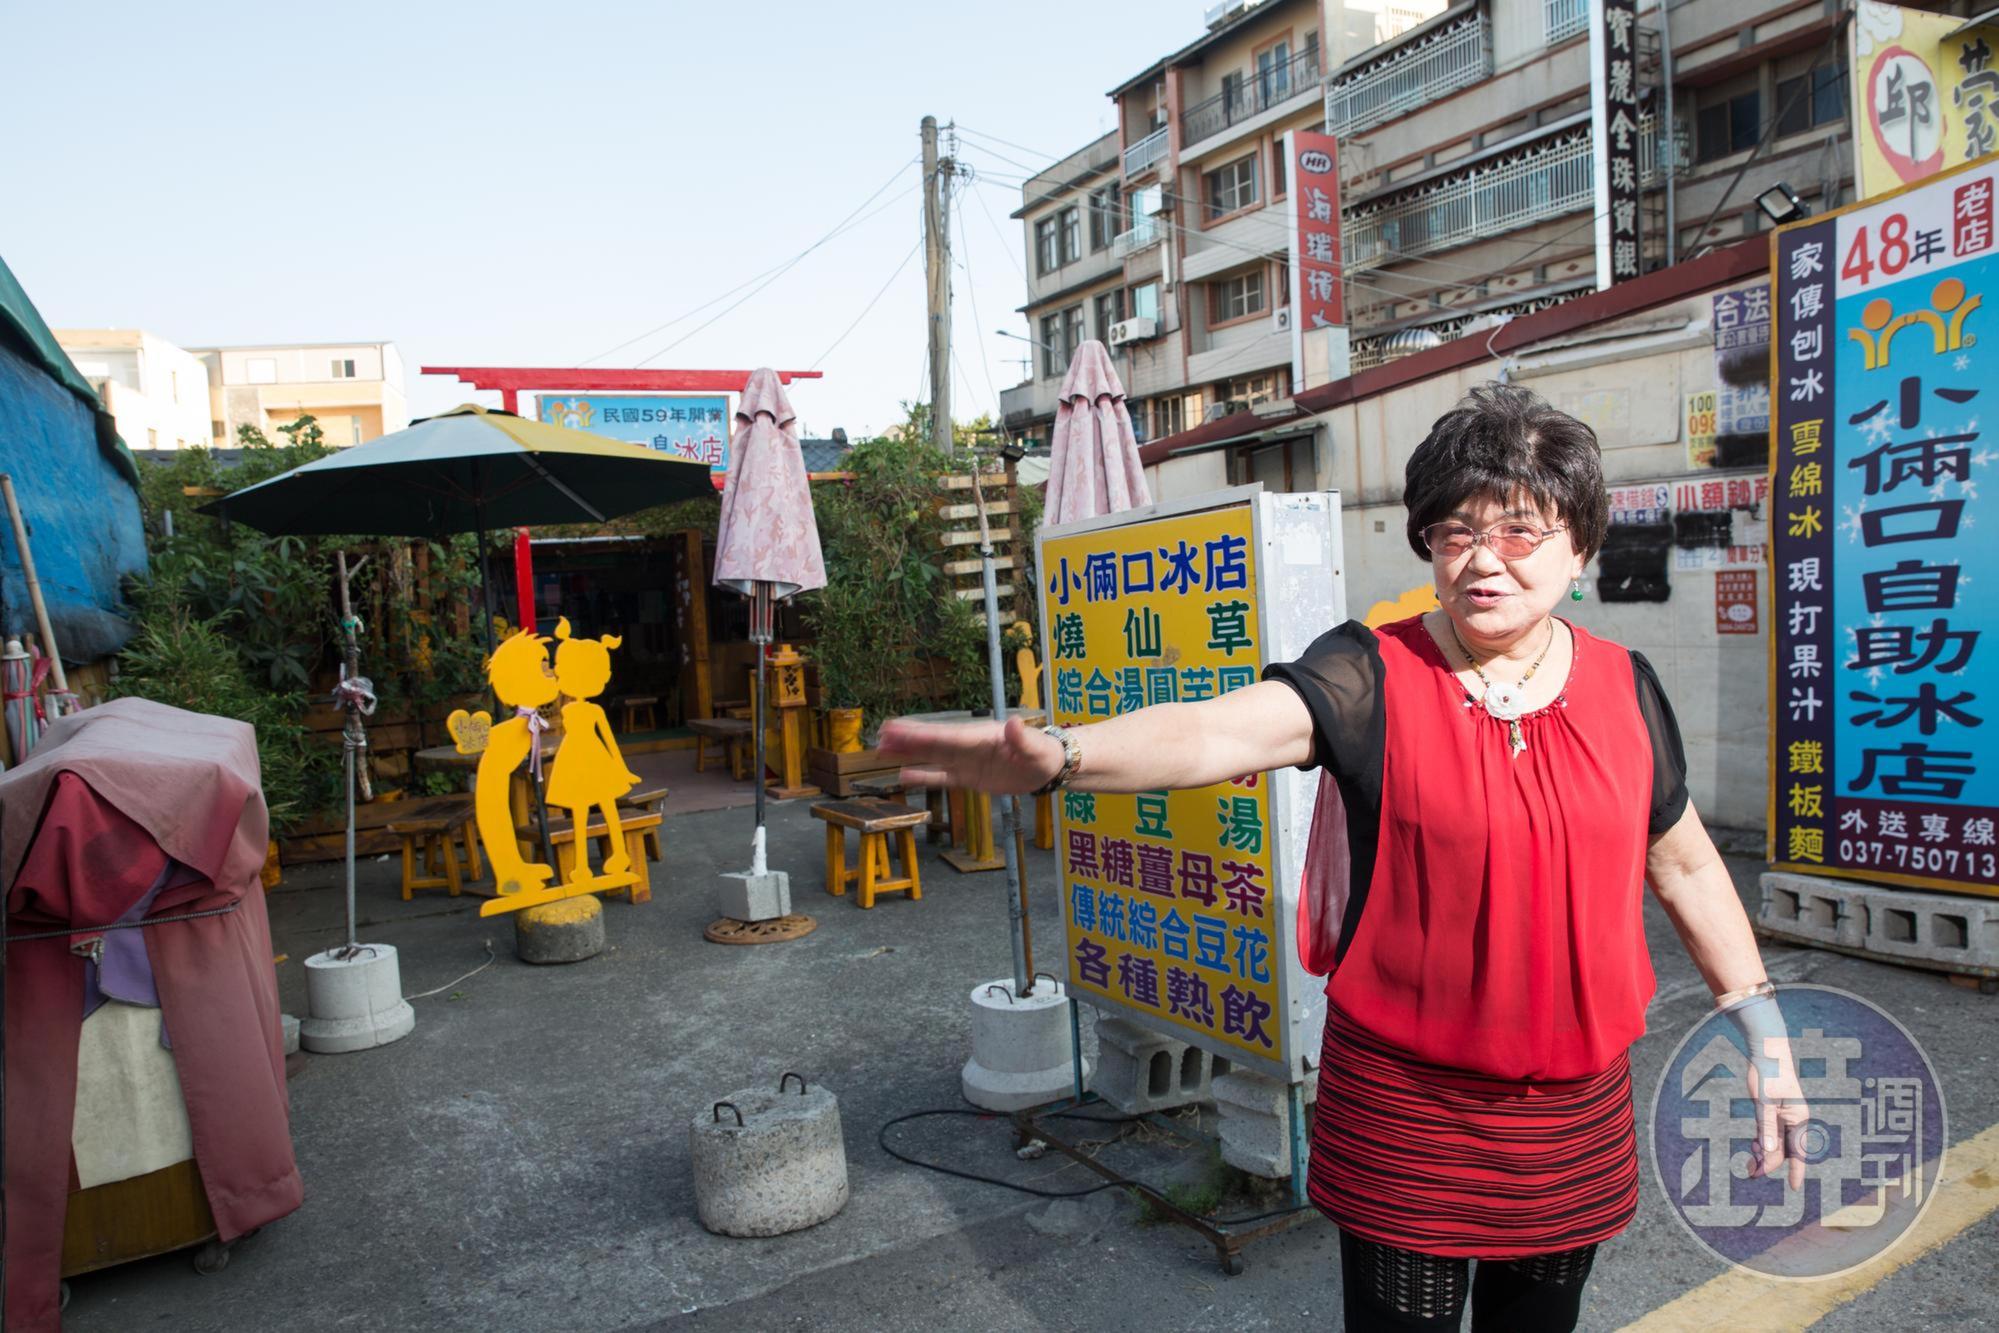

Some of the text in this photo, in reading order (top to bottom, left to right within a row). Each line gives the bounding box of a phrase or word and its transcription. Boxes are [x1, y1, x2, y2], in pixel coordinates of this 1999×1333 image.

[1841, 182, 1990, 286] 48年 老店
[1715, 288, 1769, 328] 合法
[604, 407, 724, 424] 民國59年開業
[675, 435, 722, 465] 冰店
[1050, 534, 1247, 605] 小倆口冰店
[1788, 242, 1825, 864] 家傳刨冰 雪綿冰 現打果汁 鐵板麵
[1847, 375, 1985, 800] 小倆口自助冰店
[1053, 600, 1253, 660] 燒仙草
[1063, 790, 1263, 855] 綠豆湯
[1840, 808, 1997, 846] 外送專線
[1068, 829, 1266, 919] 黑糖薑母茶
[1840, 839, 1997, 878] 037-750713
[1071, 883, 1271, 984] 傳統綜合豆花
[1075, 937, 1274, 1049] 各種熱飲
